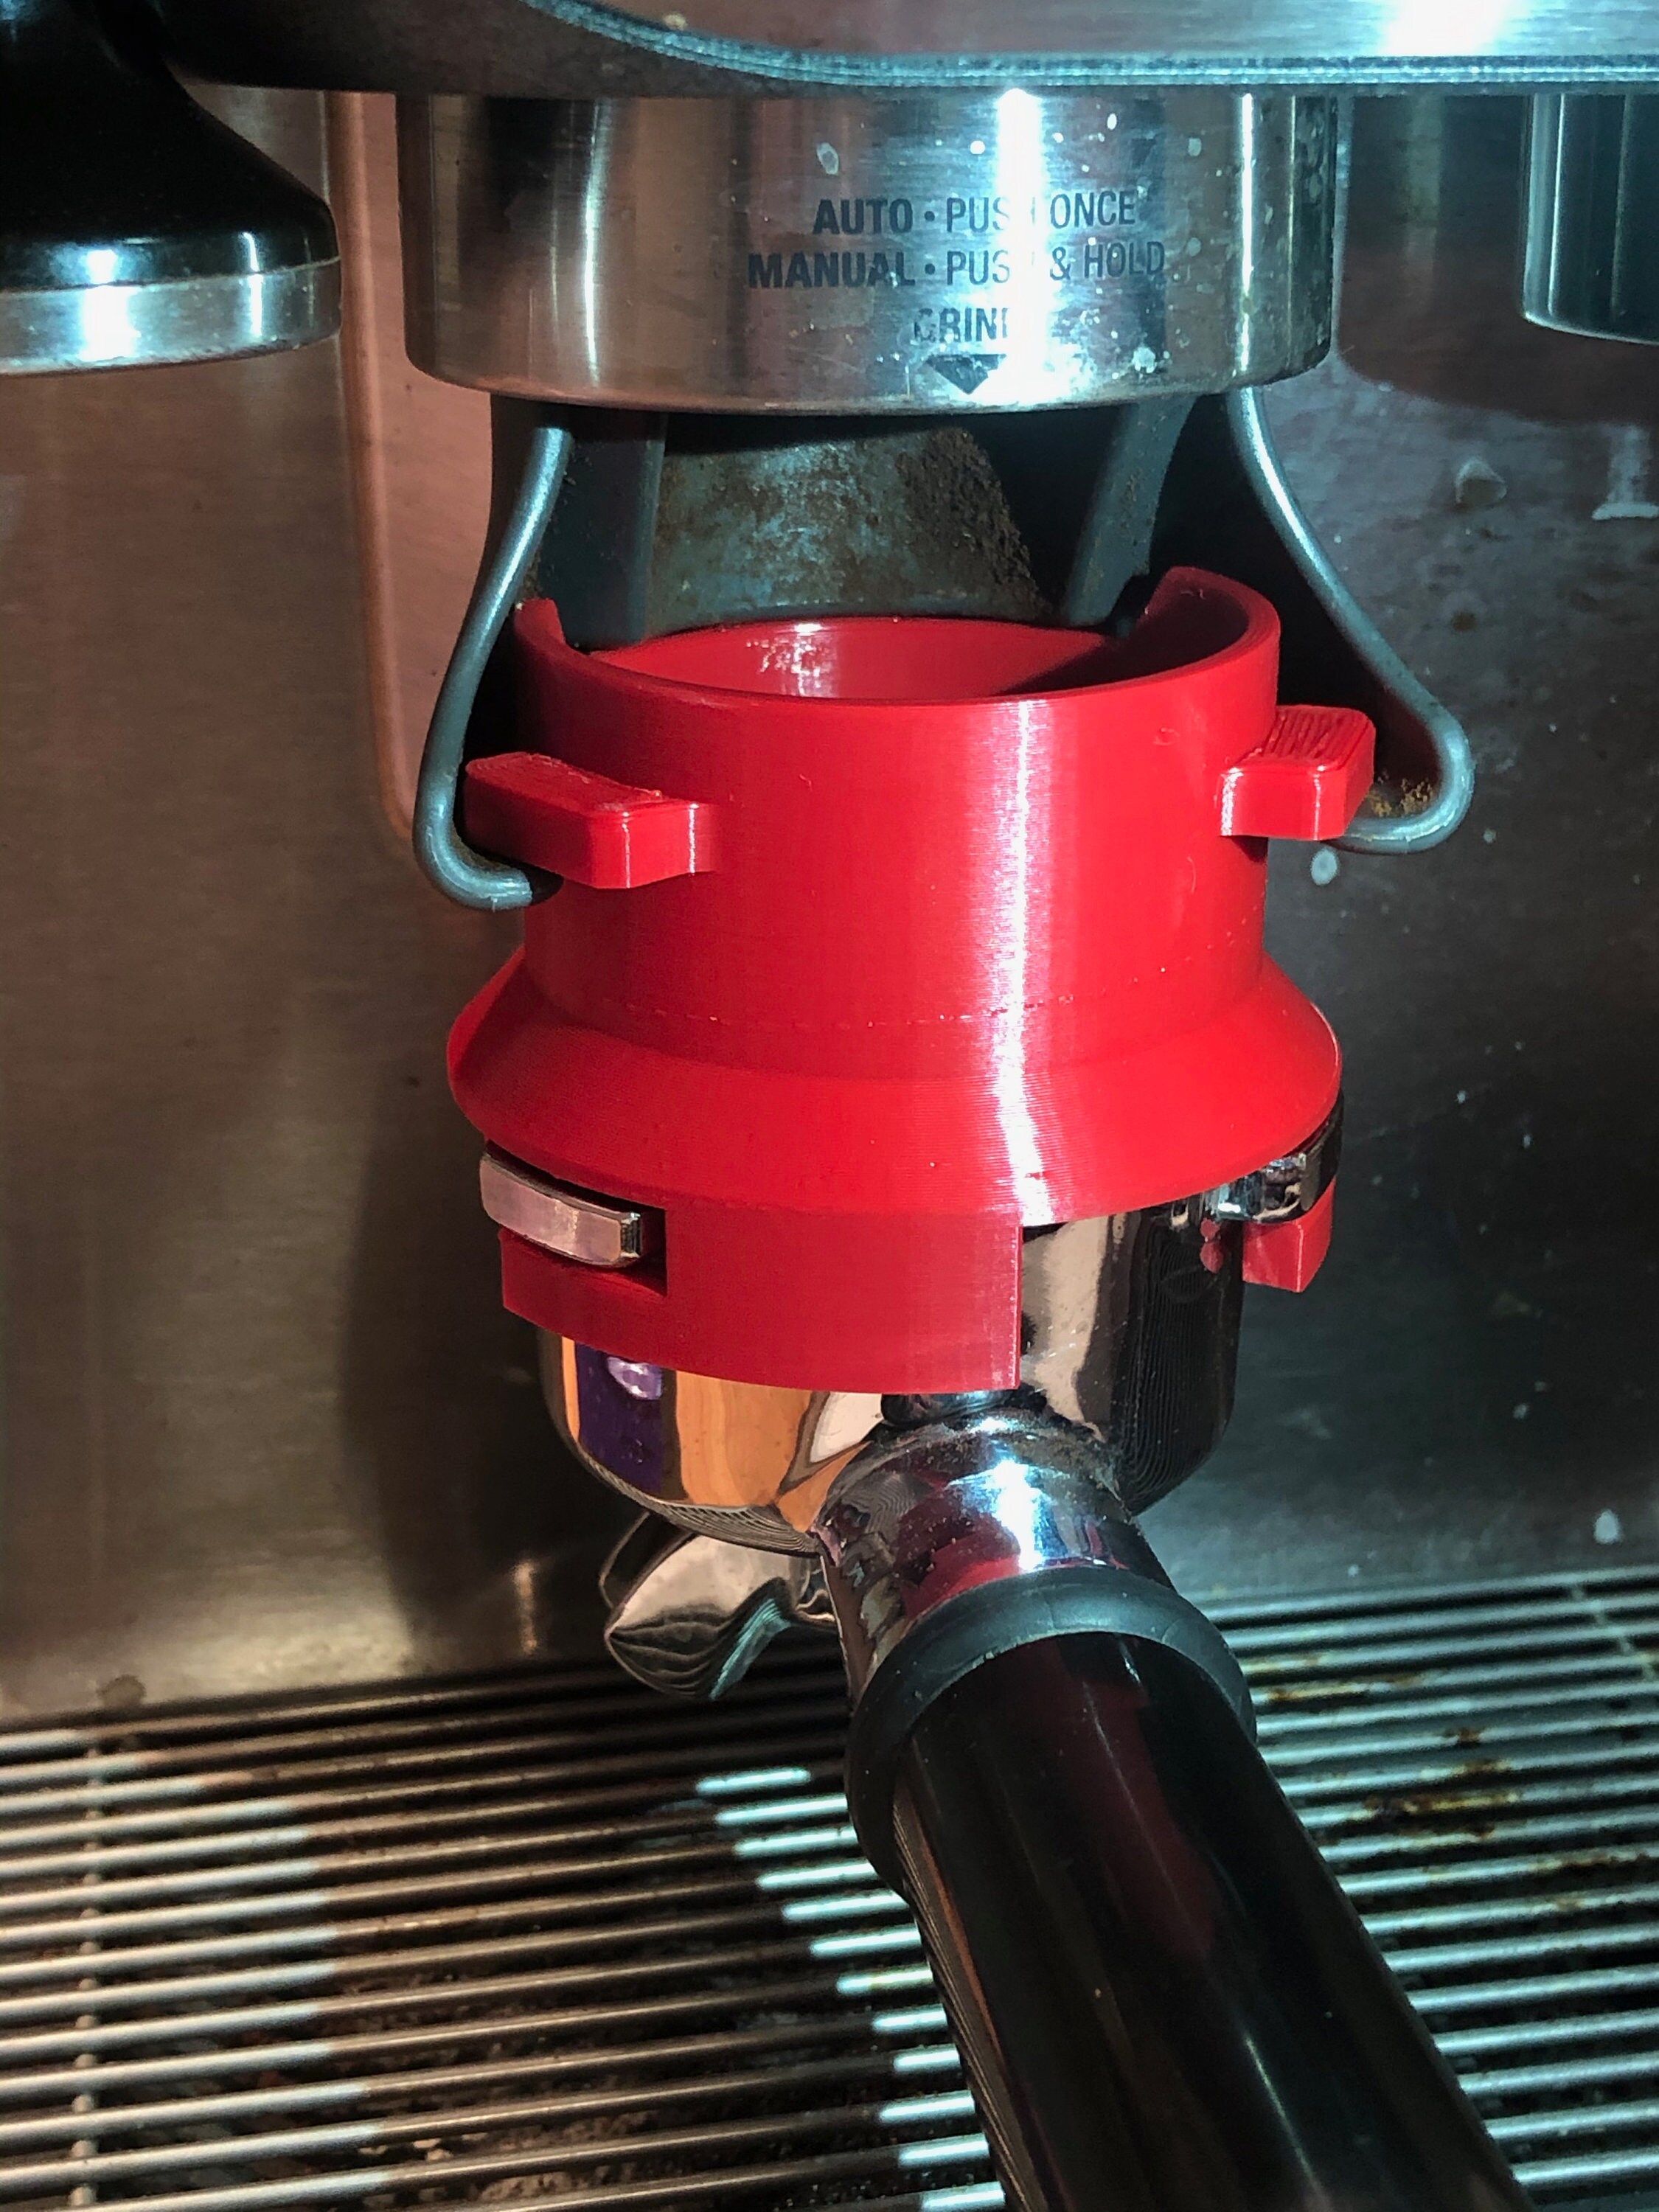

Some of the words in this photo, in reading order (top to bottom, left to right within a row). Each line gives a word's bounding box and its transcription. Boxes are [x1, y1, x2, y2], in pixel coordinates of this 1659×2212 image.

[813, 198, 914, 235] AUTO
[1050, 191, 1135, 228] ONCE
[748, 252, 916, 288] MANUAL
[947, 249, 1036, 285] PUS
[1050, 246, 1071, 280] &
[1084, 241, 1165, 278] HOLD
